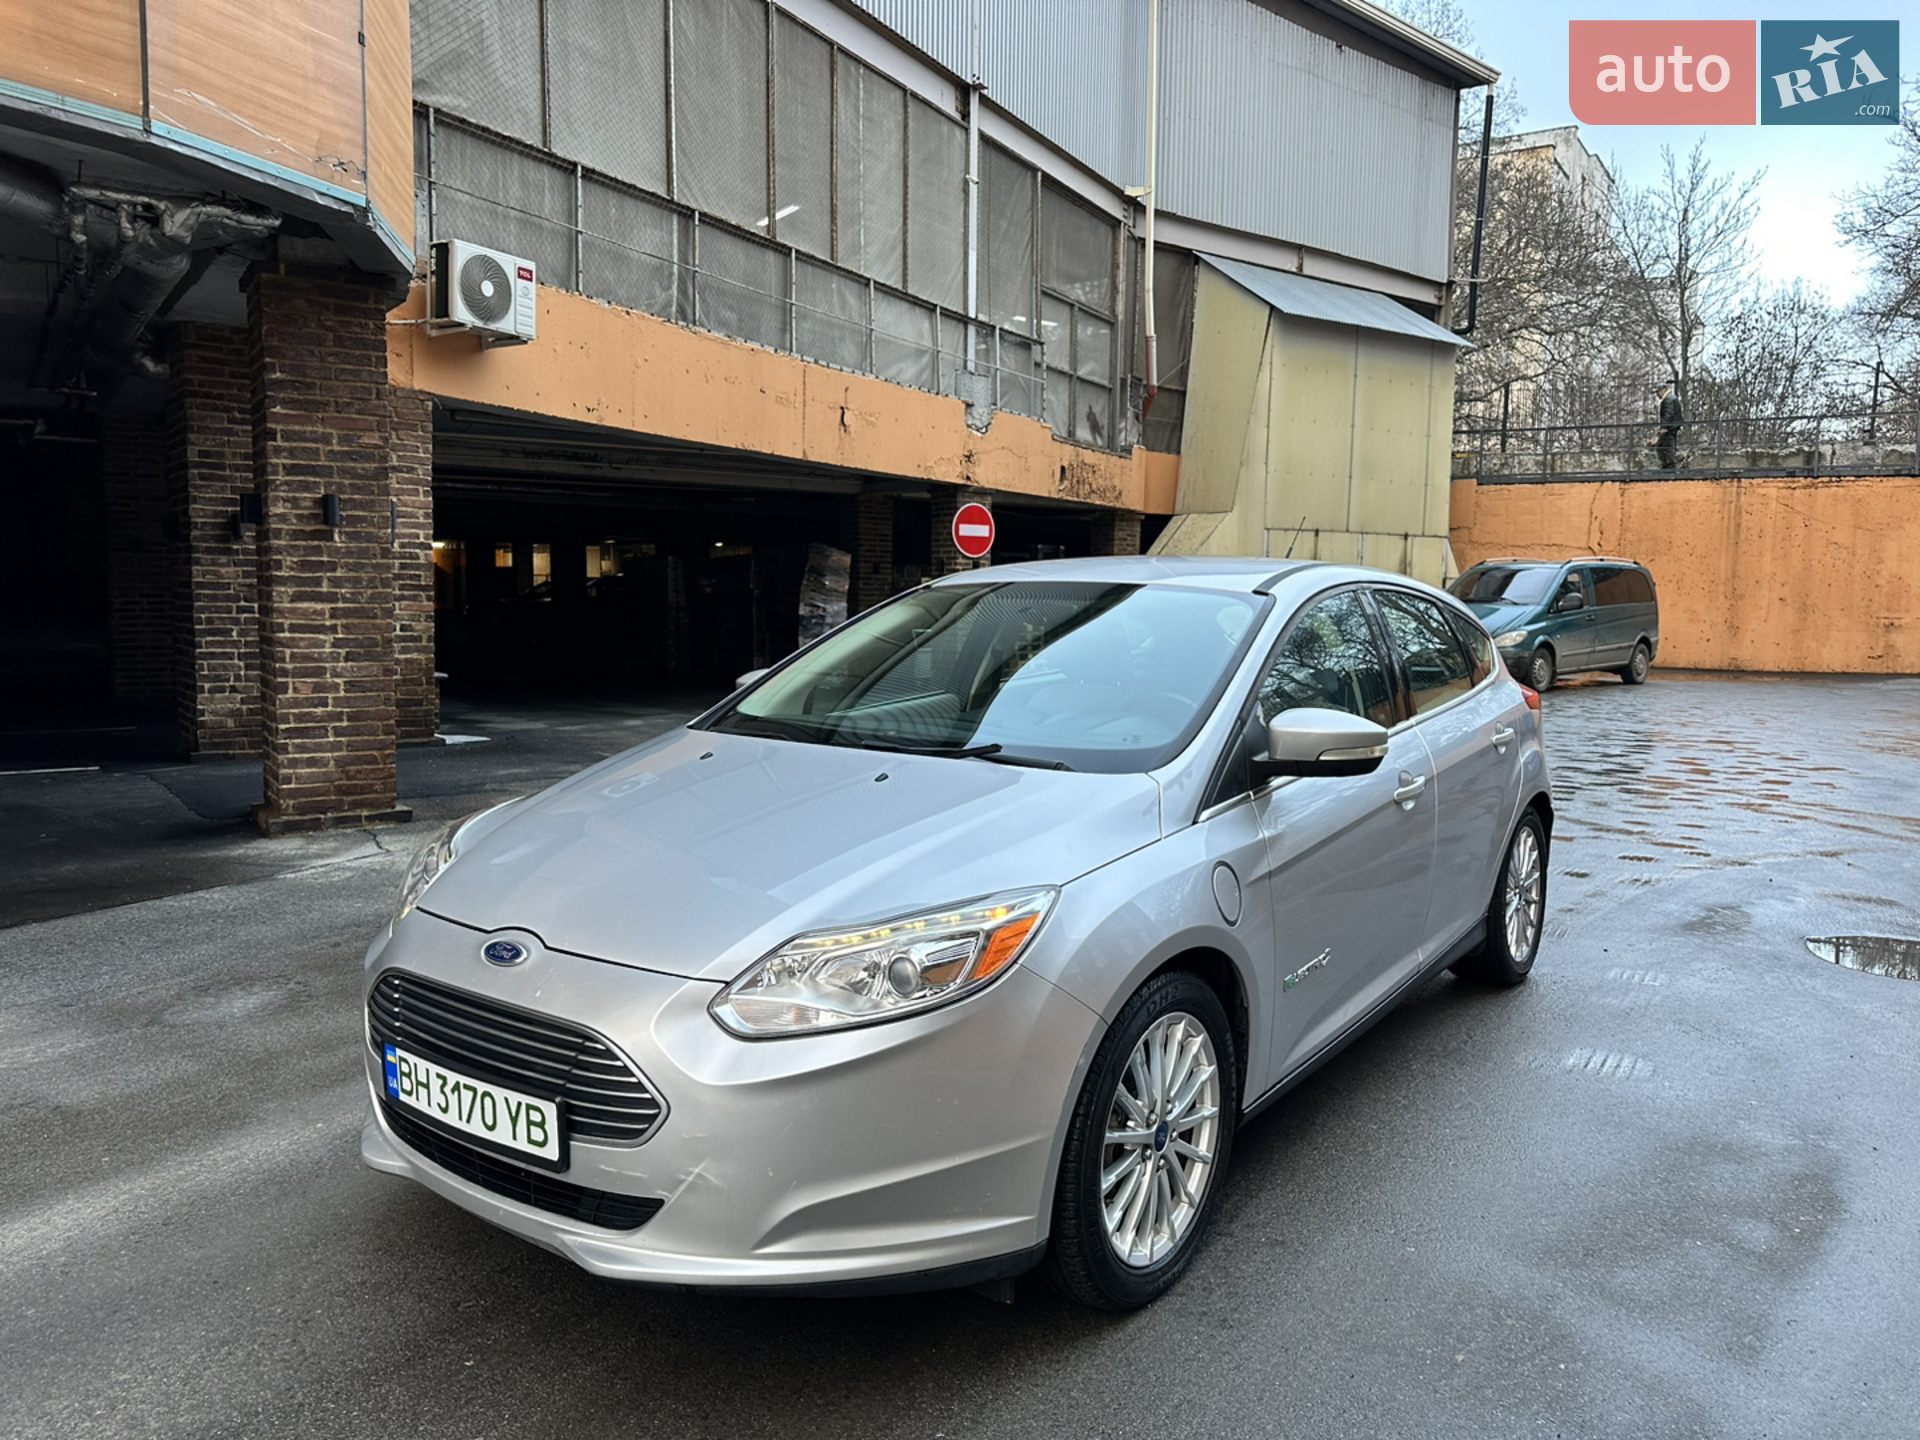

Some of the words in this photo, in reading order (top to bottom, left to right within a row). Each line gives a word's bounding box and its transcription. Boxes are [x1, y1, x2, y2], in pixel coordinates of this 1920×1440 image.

[489, 943, 516, 959] Ford
[398, 1055, 431, 1107] BH
[436, 1071, 497, 1132] 3170
[504, 1096, 549, 1148] YB
